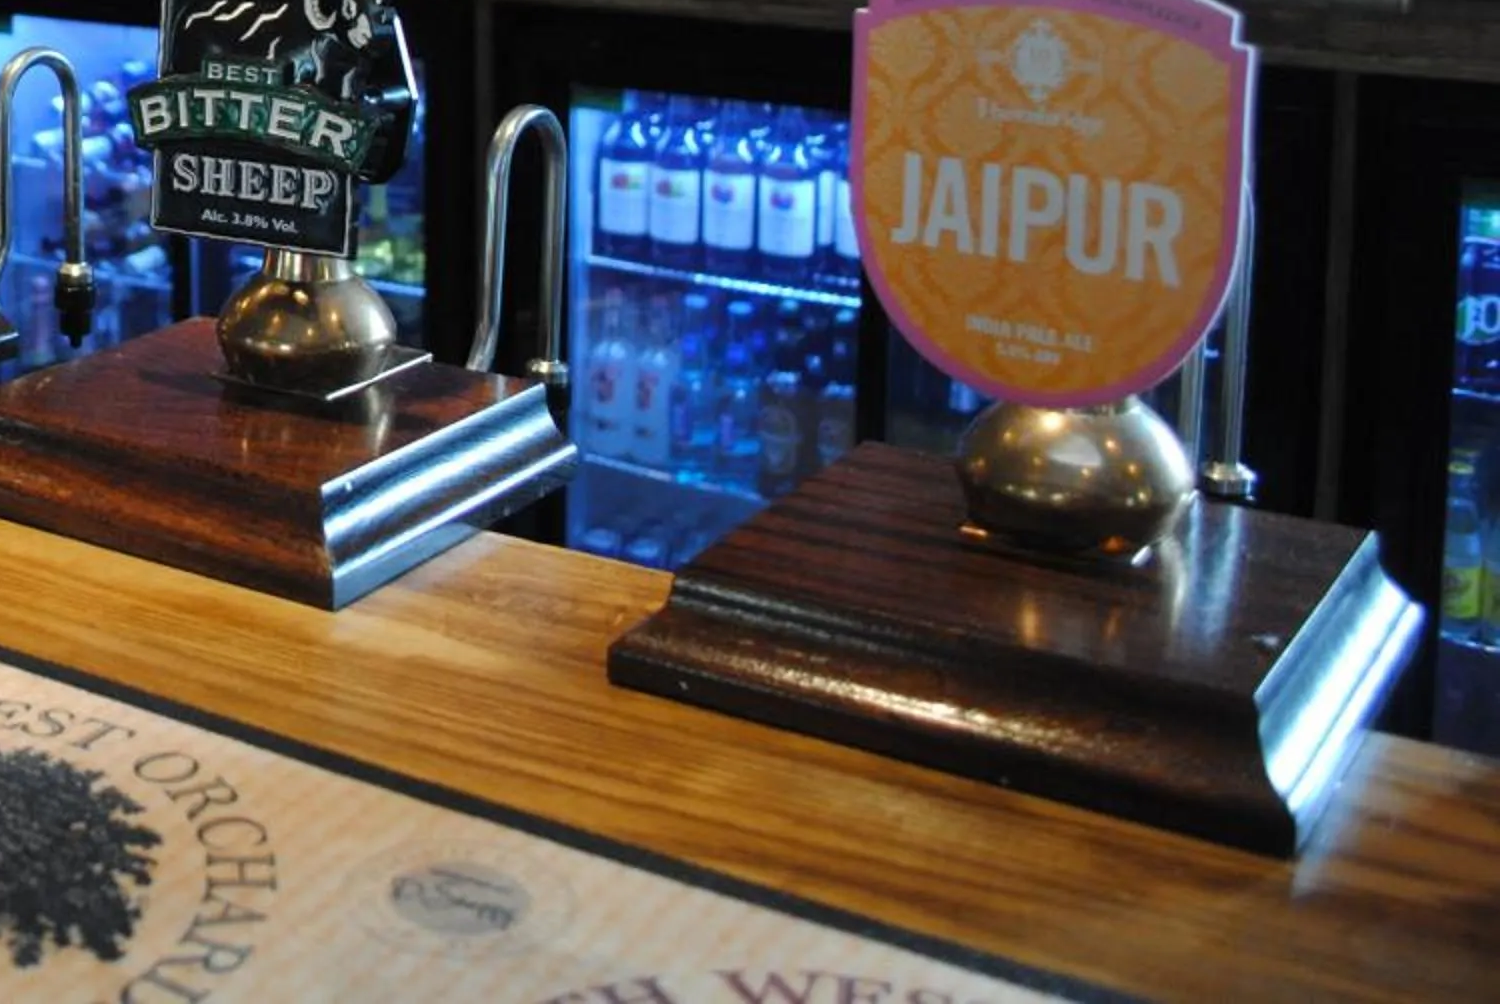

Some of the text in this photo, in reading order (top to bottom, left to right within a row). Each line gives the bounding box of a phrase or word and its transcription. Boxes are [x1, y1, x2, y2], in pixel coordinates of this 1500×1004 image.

[206, 62, 279, 86] BEST
[139, 88, 356, 157] BITTER
[172, 153, 336, 210] SHEEP
[890, 151, 1184, 289] JAIPUR
